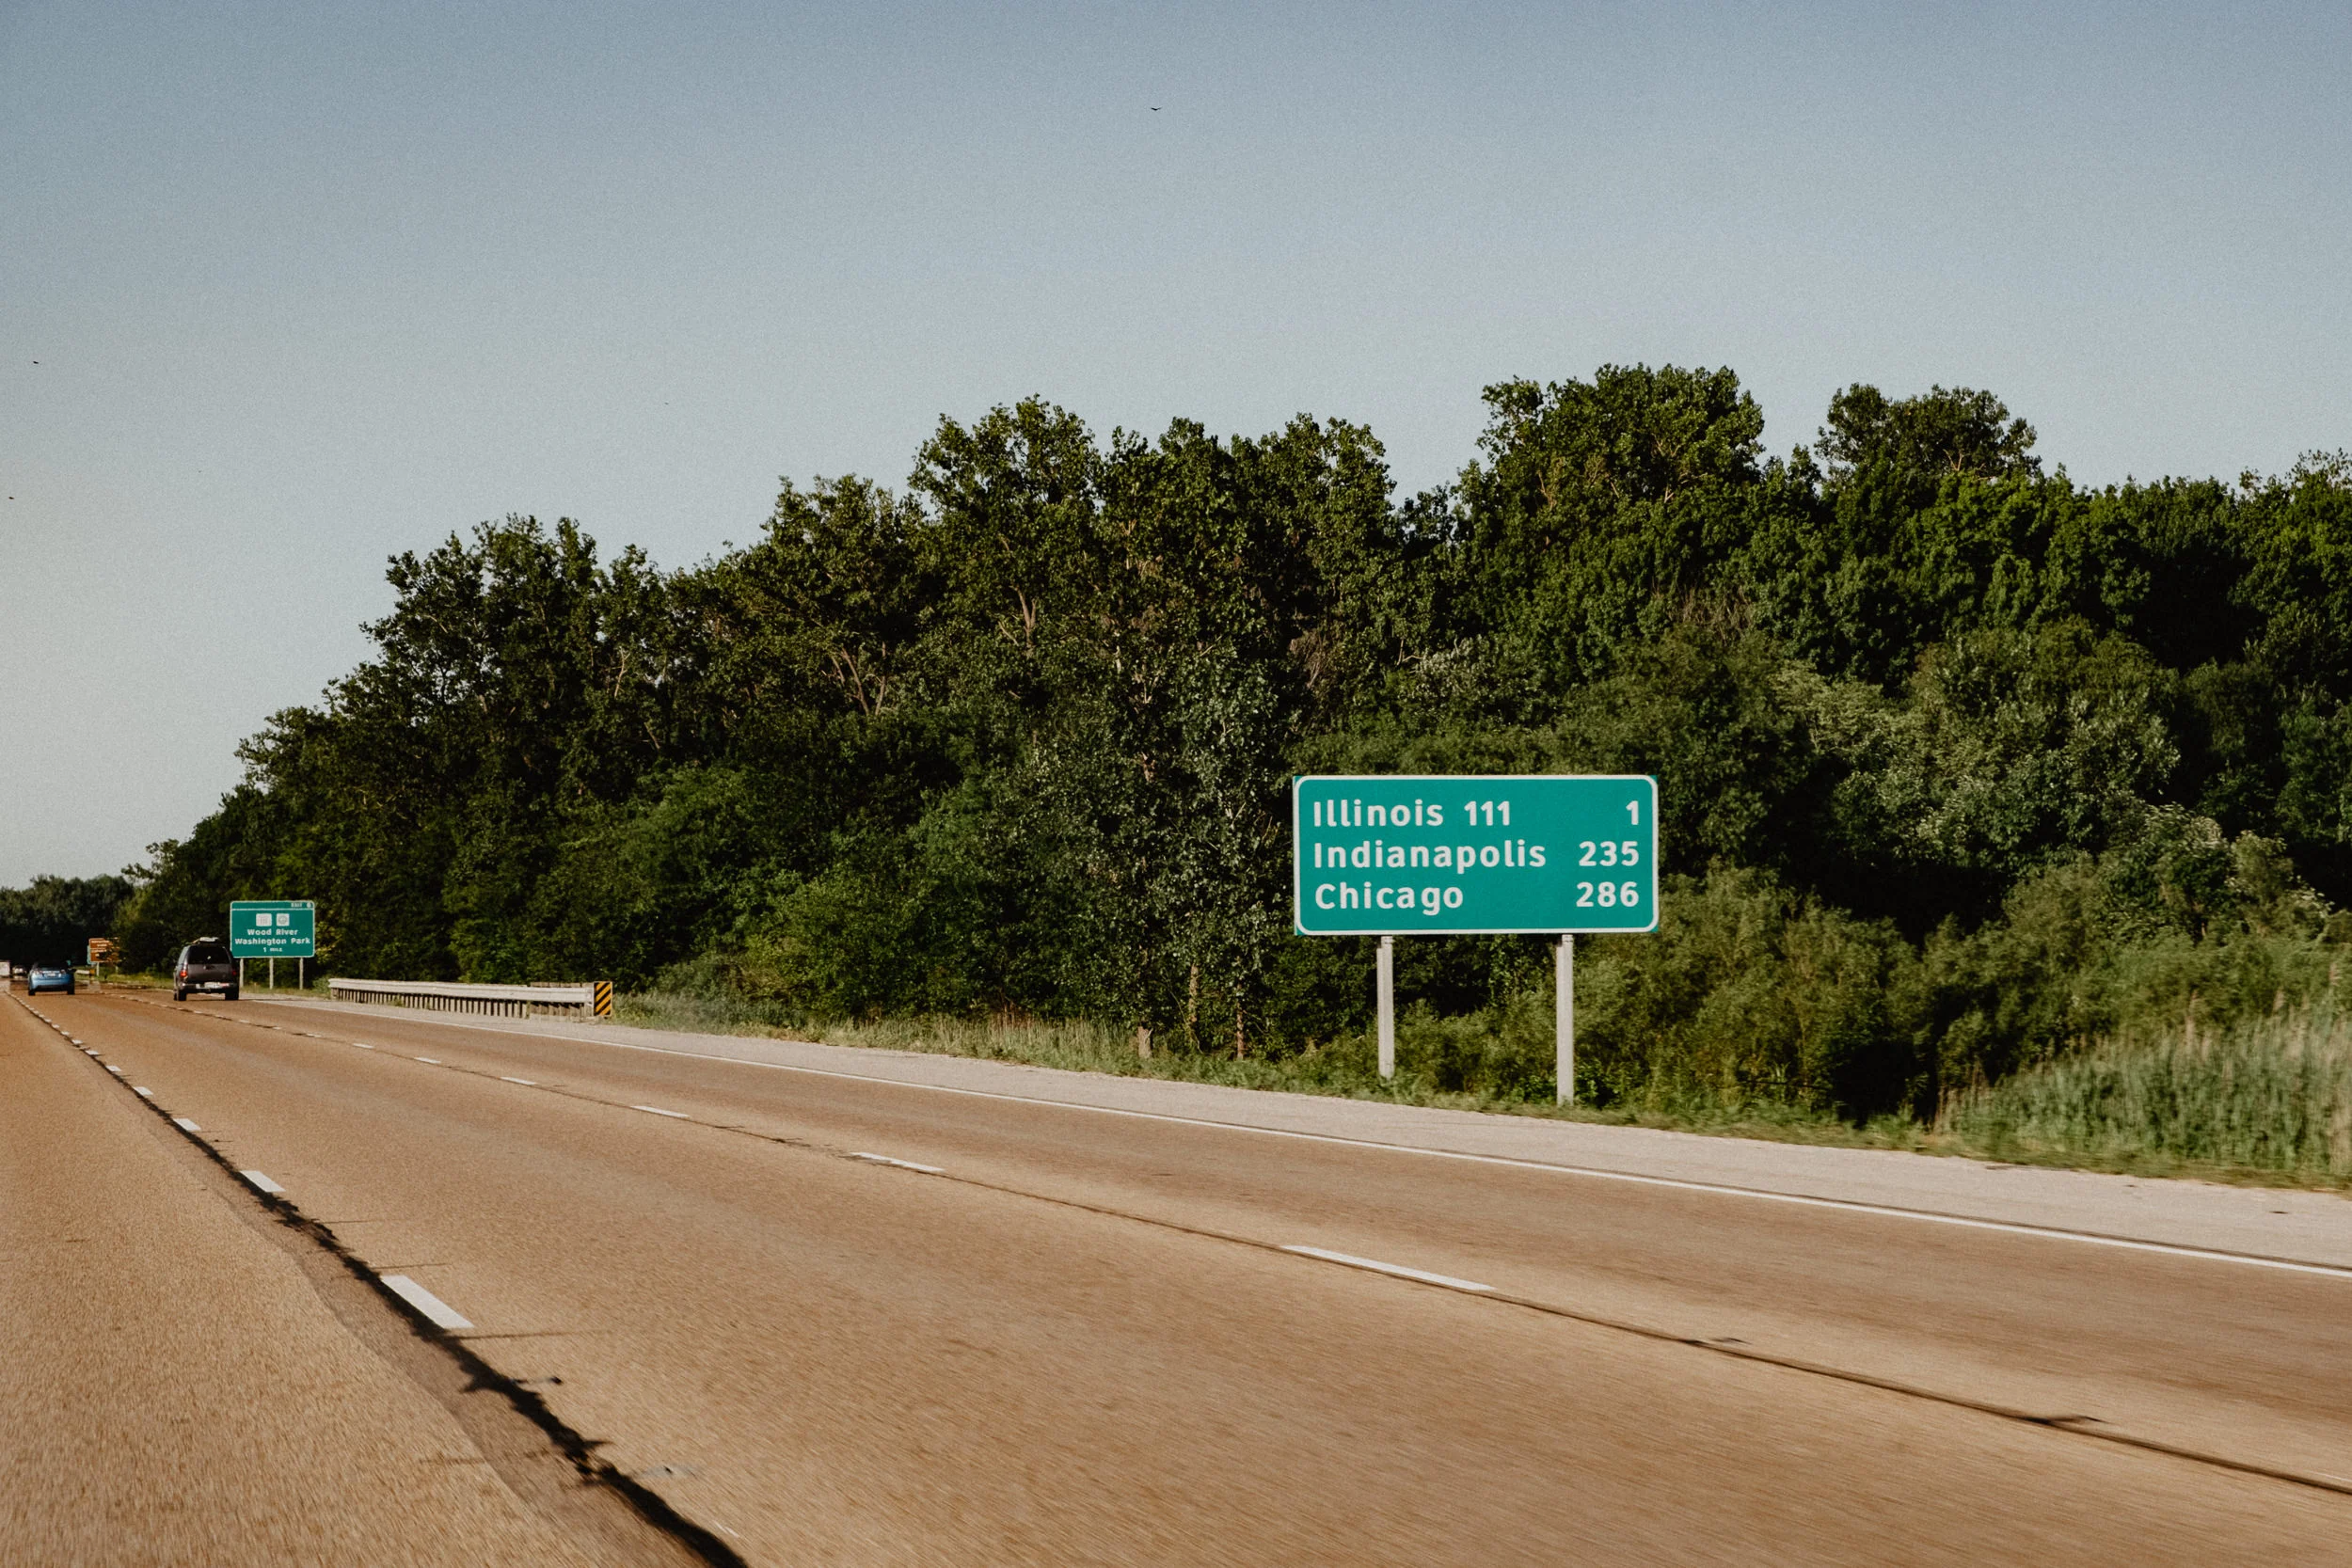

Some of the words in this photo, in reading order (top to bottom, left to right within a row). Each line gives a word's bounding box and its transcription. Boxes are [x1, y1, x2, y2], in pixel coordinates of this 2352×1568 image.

[1314, 800, 1443, 826] Illinois
[1465, 801, 1509, 825] 111
[1627, 801, 1638, 825] 1
[1315, 839, 1545, 874] Indianapolis
[1580, 841, 1638, 865] 235
[1316, 882, 1462, 915] Chicago
[1577, 882, 1638, 907] 286
